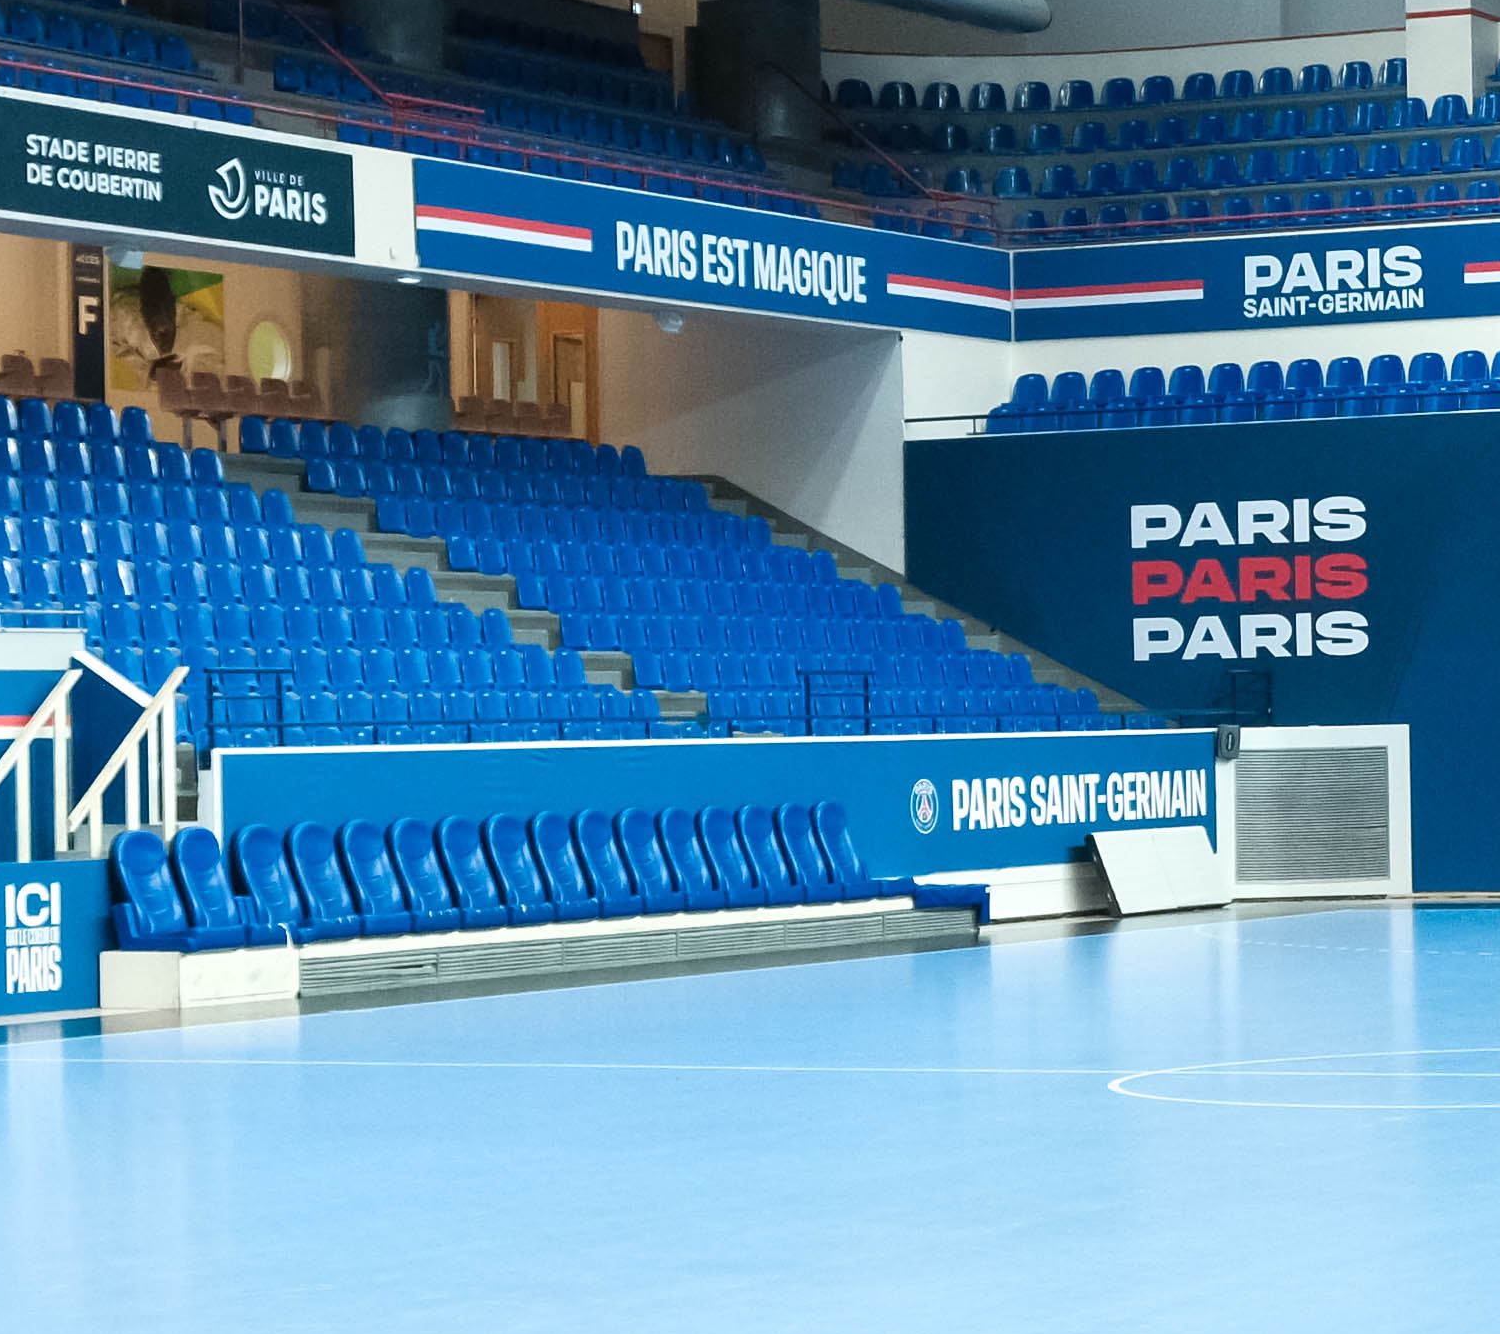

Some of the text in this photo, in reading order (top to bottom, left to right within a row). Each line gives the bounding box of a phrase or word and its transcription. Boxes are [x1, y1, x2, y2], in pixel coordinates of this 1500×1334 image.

[26, 134, 162, 174] STADE PIERRE
[254, 169, 305, 187] VILLE DE
[26, 163, 164, 203] DE COUBERTIN
[254, 184, 328, 225] PARIS
[616, 221, 868, 306] PARIS EST MAGIQUE
[1244, 245, 1423, 296] PARIS
[78, 295, 99, 336] F
[1243, 287, 1424, 319] SAINT-GERMAIN
[1130, 495, 1367, 549] PARIS
[1131, 553, 1369, 605] PARIS
[1132, 610, 1370, 662] PARIS
[952, 768, 1207, 831] PARIS SAINT-GERMAIN
[5, 881, 62, 928] ICI
[5, 944, 63, 995] PARIS
